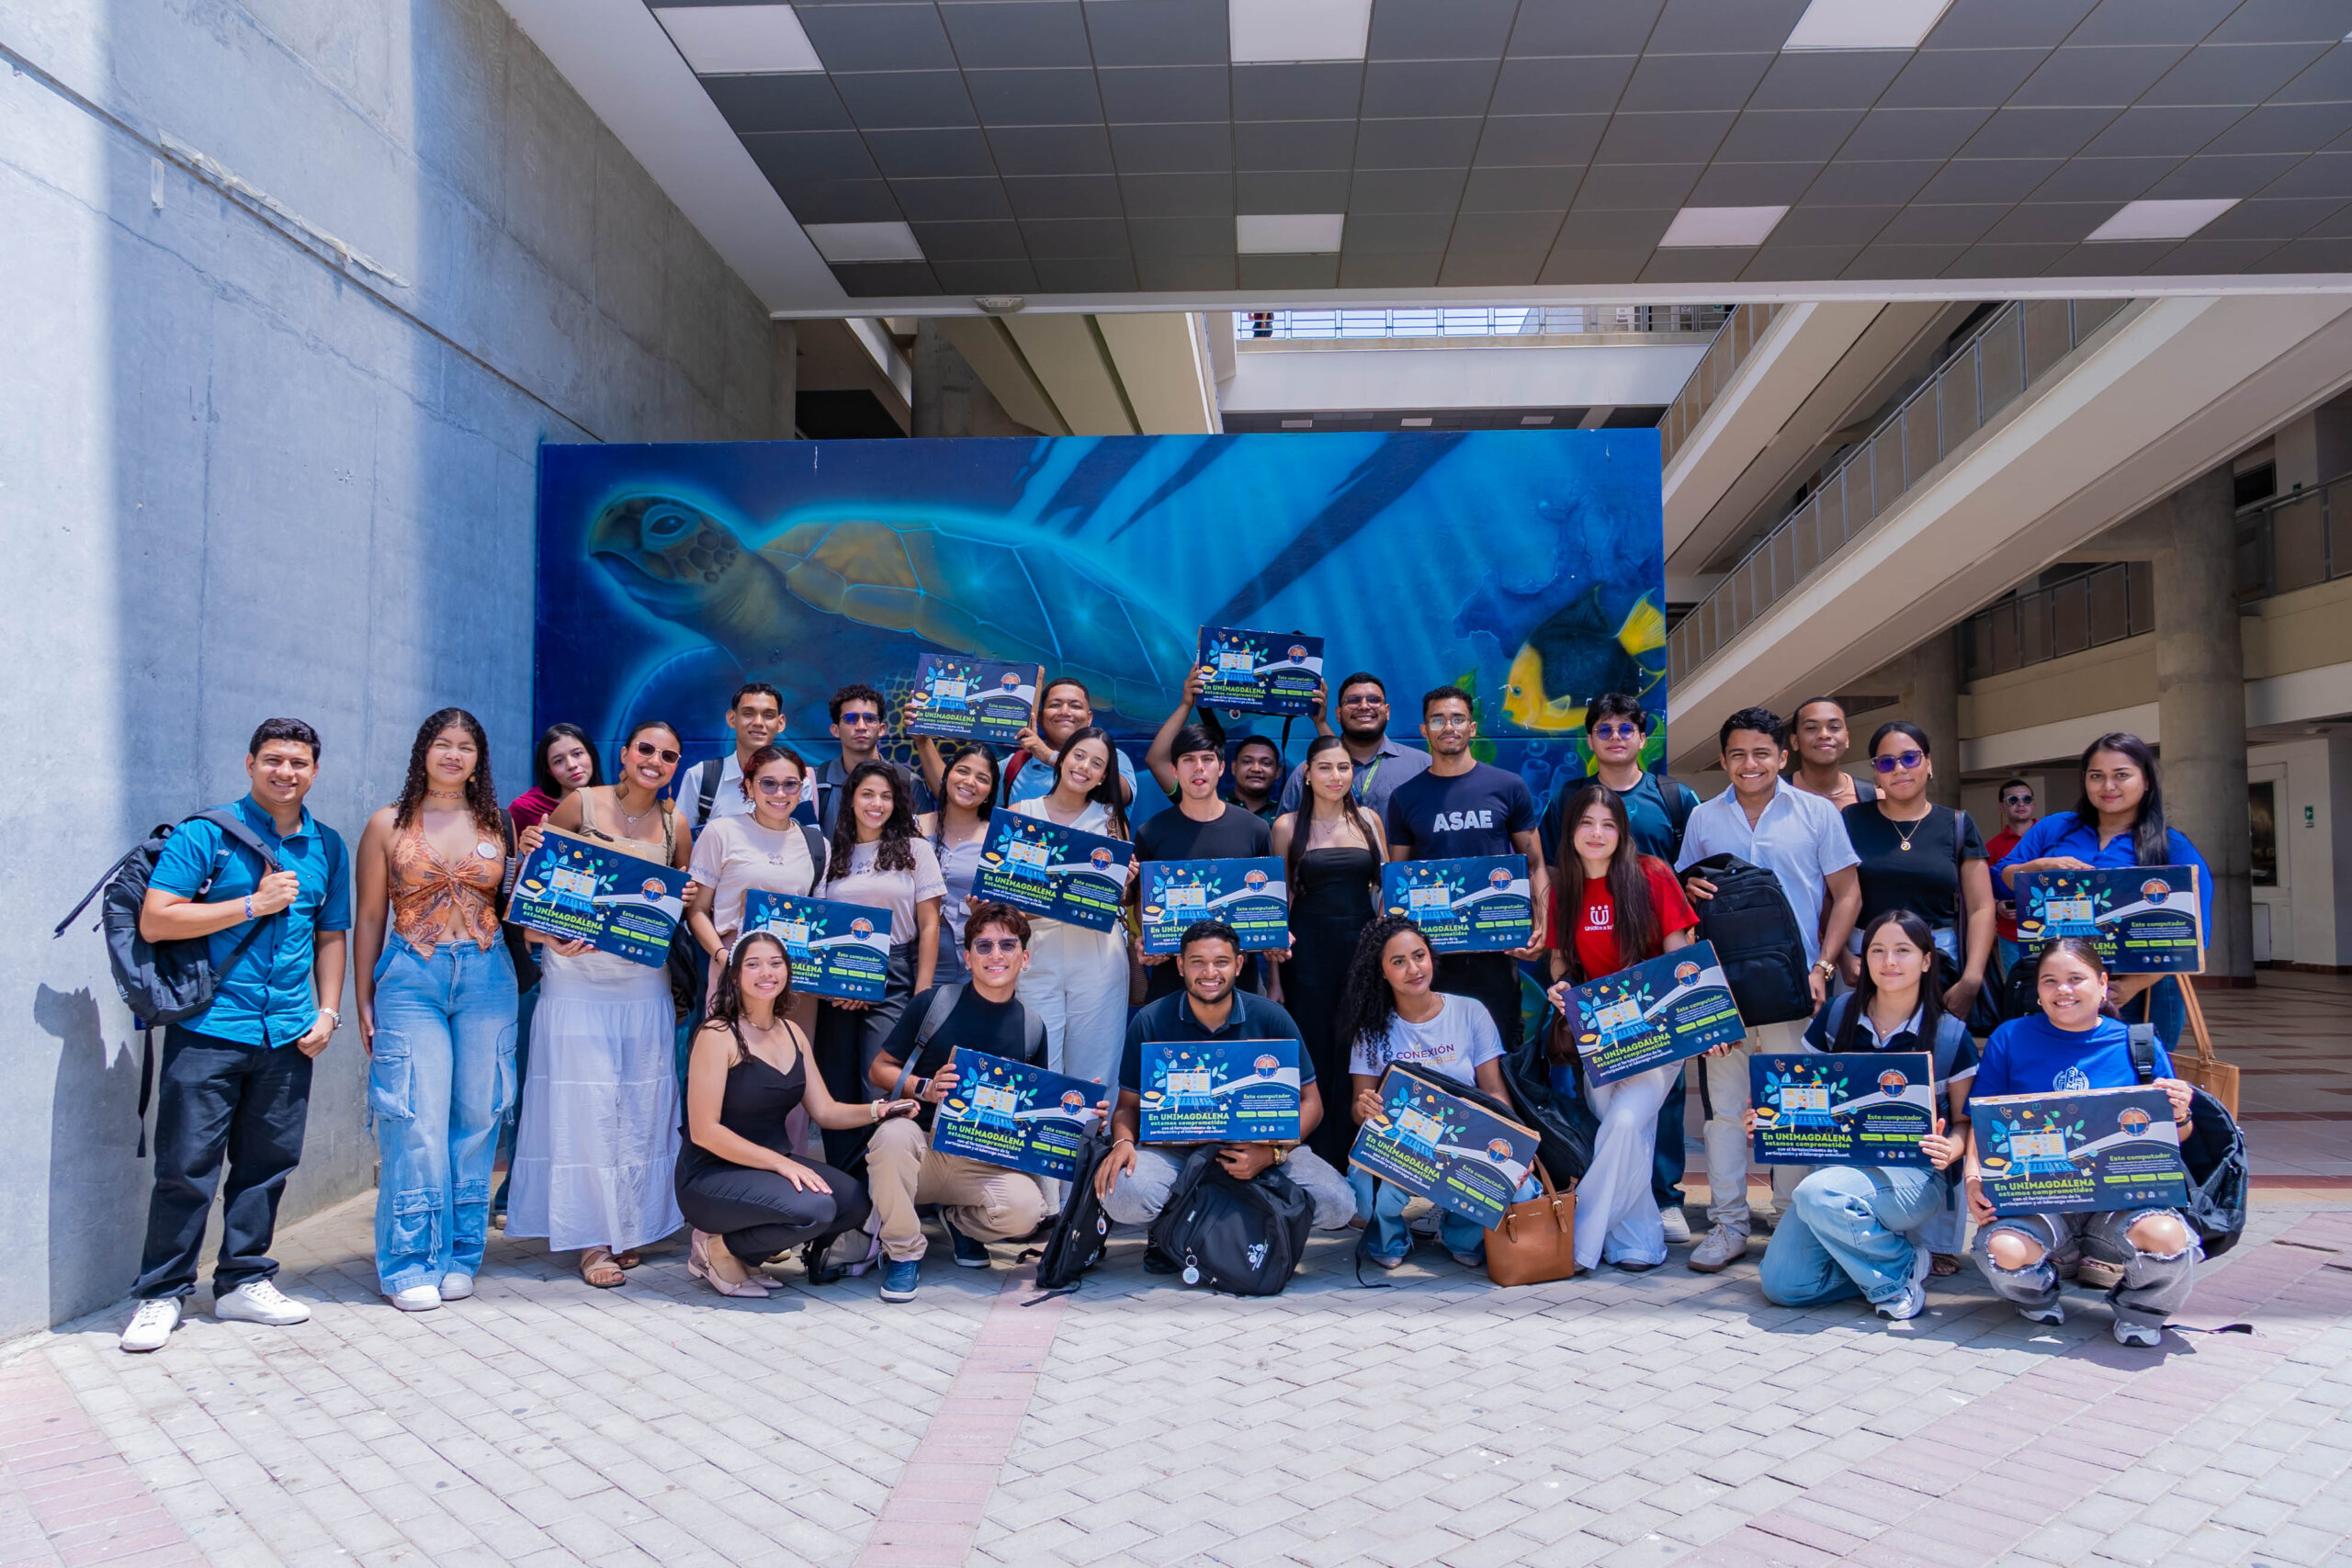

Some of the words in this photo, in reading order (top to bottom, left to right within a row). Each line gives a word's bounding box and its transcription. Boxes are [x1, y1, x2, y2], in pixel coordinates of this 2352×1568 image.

[1213, 684, 1266, 694] UNIMAGDALENA
[924, 711, 976, 723] UNIMAGDALENA
[1433, 810, 1493, 833] ASAE
[983, 873, 993, 881] En
[994, 875, 1057, 897] UNIMAGDALENA
[984, 881, 1008, 890] estamos
[1009, 887, 1053, 902] comprometidos
[1085, 882, 1116, 893] computador
[522, 902, 533, 911] En
[535, 905, 603, 931] UNIMAGDALENA
[523, 910, 549, 921] estamos
[550, 919, 599, 935] comprometidos
[634, 915, 668, 927] computador
[1420, 924, 1470, 933] MAGDALENA
[849, 954, 881, 963] computador
[791, 962, 822, 974] DALENA
[1689, 993, 1723, 1009] computador
[1396, 1043, 1454, 1059] CONEXIÓN
[1597, 1056, 1623, 1068] estamos
[1623, 1040, 1670, 1059] comprometidos
[1603, 1032, 1671, 1060] UNIMAGDALENA
[1160, 1112, 1230, 1121] UNIMAGDALENA
[946, 1122, 957, 1131] En
[958, 1124, 1025, 1147] UNIMAGDALENA
[1043, 1124, 1055, 1133] Este
[1055, 1129, 1082, 1139] computad
[1775, 1133, 1853, 1142] UNIMAGDALENA
[947, 1131, 973, 1141] estamos
[974, 1137, 1022, 1152] comprometidos
[1365, 1134, 1376, 1145] En
[1377, 1139, 1440, 1179] UNIMAGDALENA
[1365, 1142, 1390, 1157] estamos
[1390, 1156, 1435, 1182] comprometidos
[2126, 1153, 2171, 1161] computador
[1462, 1164, 1474, 1174] Este
[1474, 1171, 1507, 1190] computador
[1994, 1183, 2007, 1191] En
[2008, 1178, 2096, 1190] UNIMAGDALENA
[2032, 1186, 2094, 1195] comprometidos
